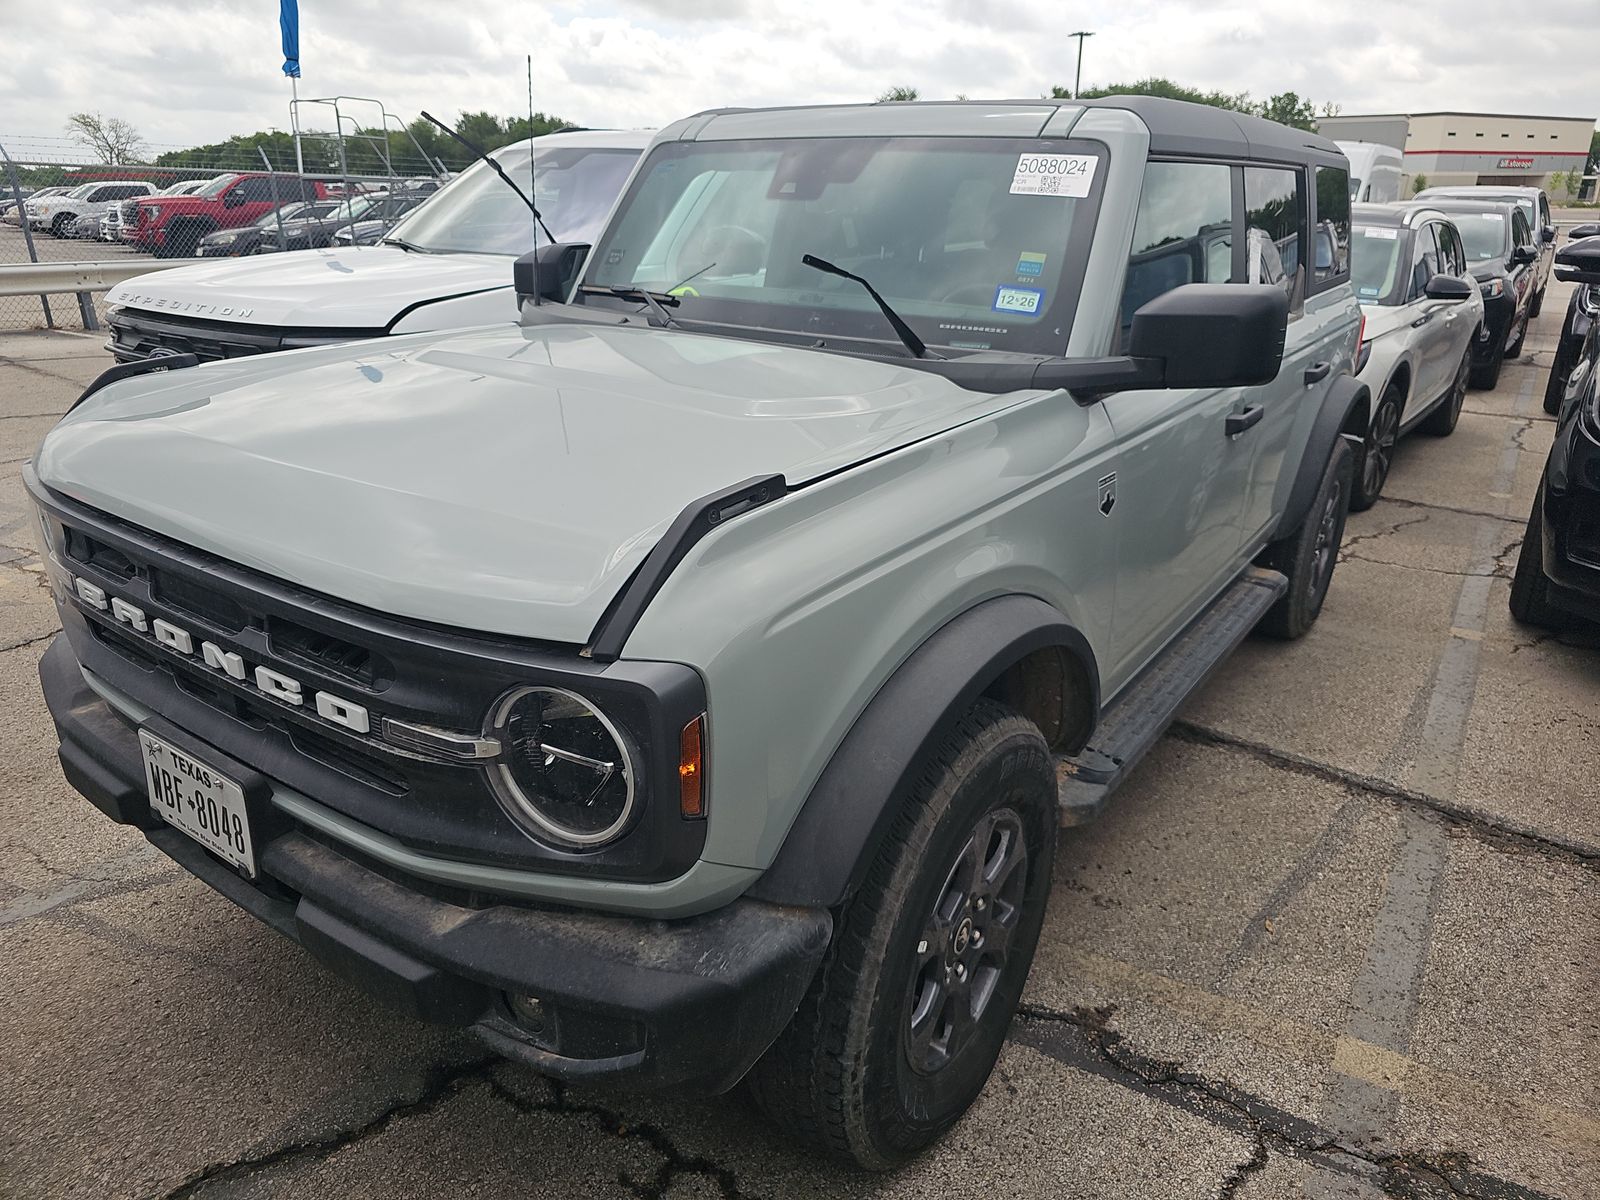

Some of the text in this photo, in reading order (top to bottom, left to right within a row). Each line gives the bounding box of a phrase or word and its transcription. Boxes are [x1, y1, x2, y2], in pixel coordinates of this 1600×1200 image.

[1018, 158, 1088, 176] 5088024
[118, 292, 254, 318] EXPEDITION
[1001, 294, 1036, 308] 12 26
[75, 576, 370, 734] BRONCO
[170, 751, 212, 789] TEXAS
[194, 789, 245, 855] 8048
